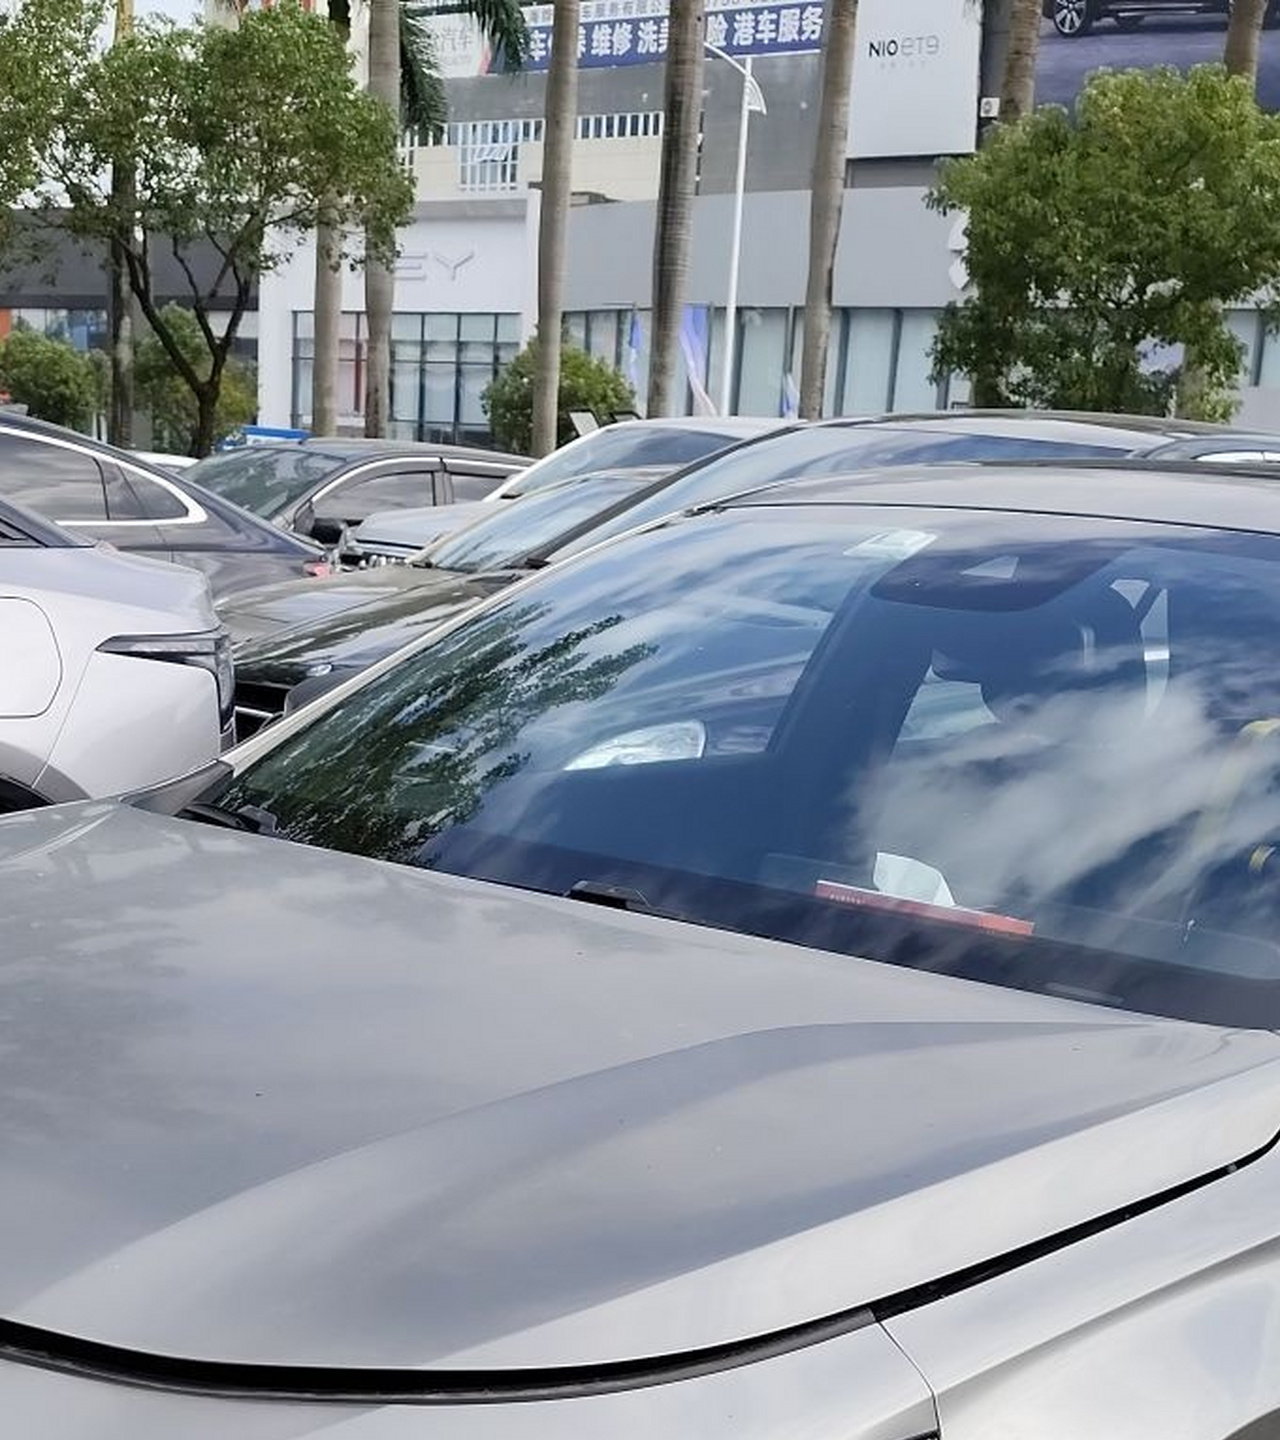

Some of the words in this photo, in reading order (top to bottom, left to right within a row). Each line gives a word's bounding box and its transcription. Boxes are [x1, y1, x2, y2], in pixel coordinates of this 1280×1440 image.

[591, 22, 632, 56] 维修
[732, 6, 823, 46] 港车服务
[869, 39, 899, 57] NIO
[394, 250, 476, 281] EY
